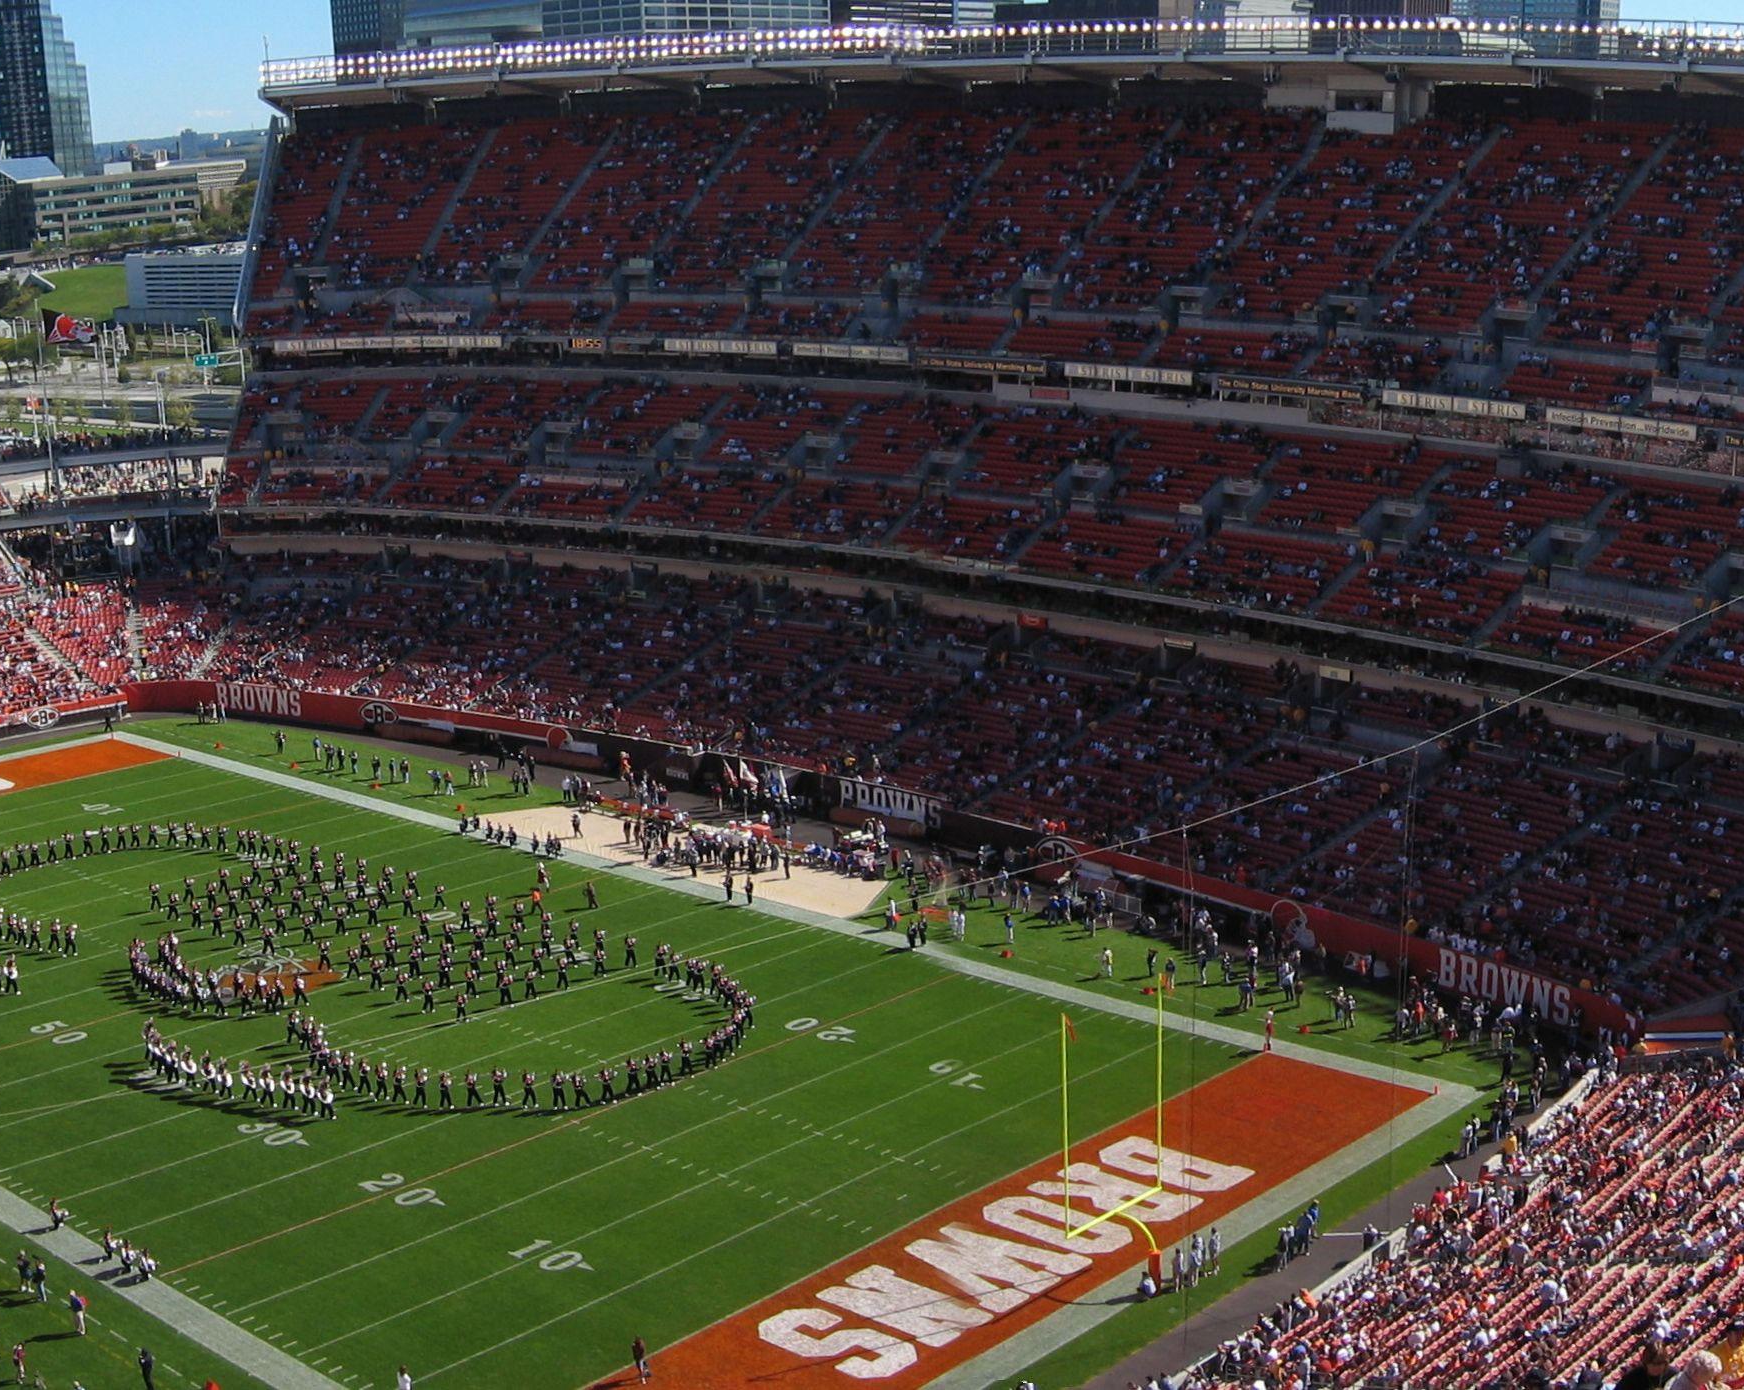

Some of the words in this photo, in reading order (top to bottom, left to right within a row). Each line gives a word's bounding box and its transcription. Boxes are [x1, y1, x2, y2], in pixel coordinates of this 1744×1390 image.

[1471, 400, 1519, 417] STERIS
[1550, 411, 1588, 424] Infection
[1725, 435, 1740, 446] The
[215, 682, 302, 717] BROWNS
[1438, 947, 1571, 1026] BROWNS
[29, 1020, 88, 1044] 50
[784, 1017, 856, 1041] 20
[237, 1121, 304, 1147] 30
[358, 1172, 438, 1206] 20
[507, 1239, 584, 1272] 10
[758, 1134, 1256, 1379] BROWNS
